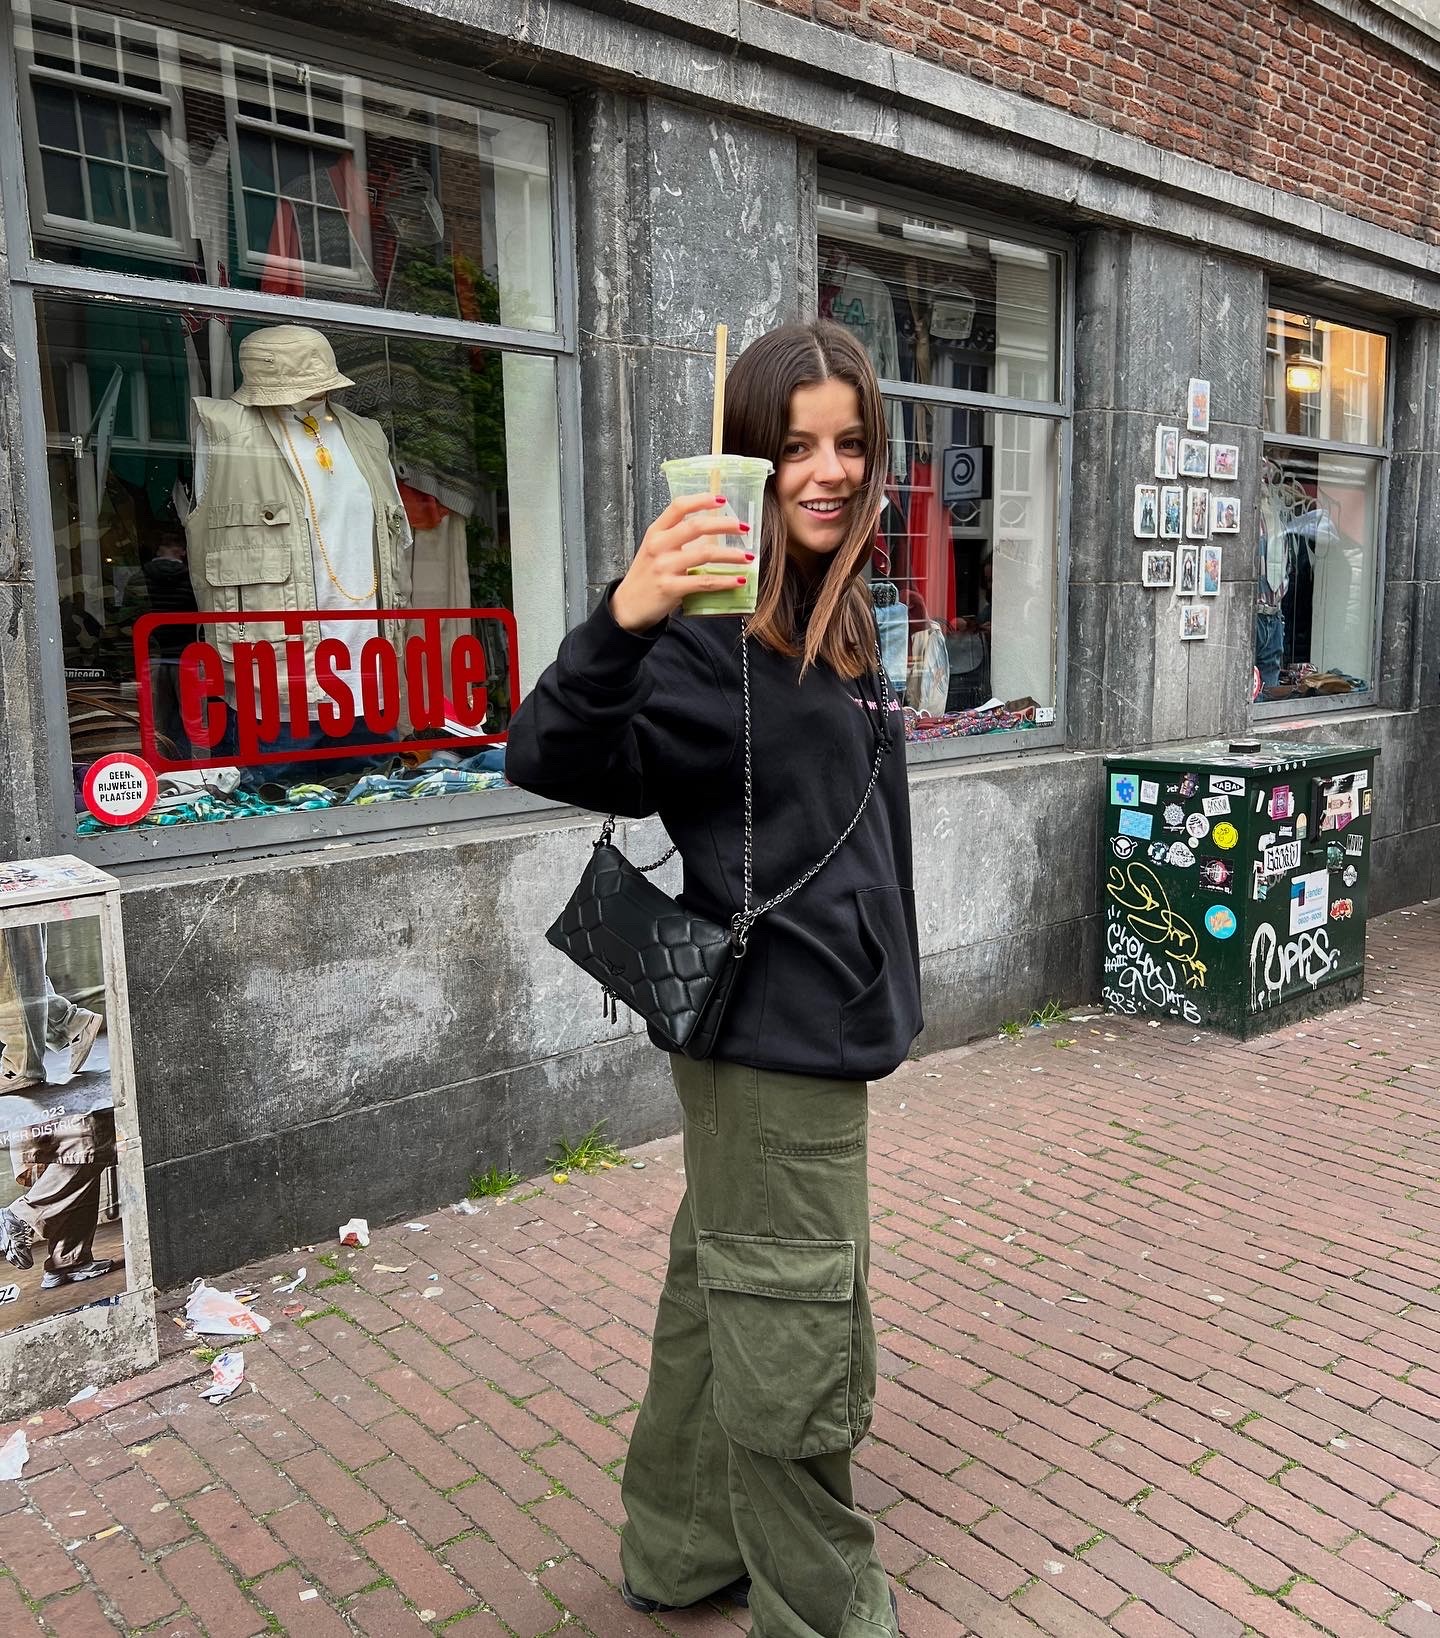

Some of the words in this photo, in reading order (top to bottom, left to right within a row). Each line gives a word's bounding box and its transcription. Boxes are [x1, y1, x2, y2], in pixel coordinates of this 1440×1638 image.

[64, 669, 100, 678] pisode
[178, 619, 488, 756] episode
[109, 771, 131, 780] GEEN
[100, 791, 142, 802] PLAATSEN
[33, 1105, 66, 1121] 2023
[32, 1117, 86, 1138] DISTRICT
